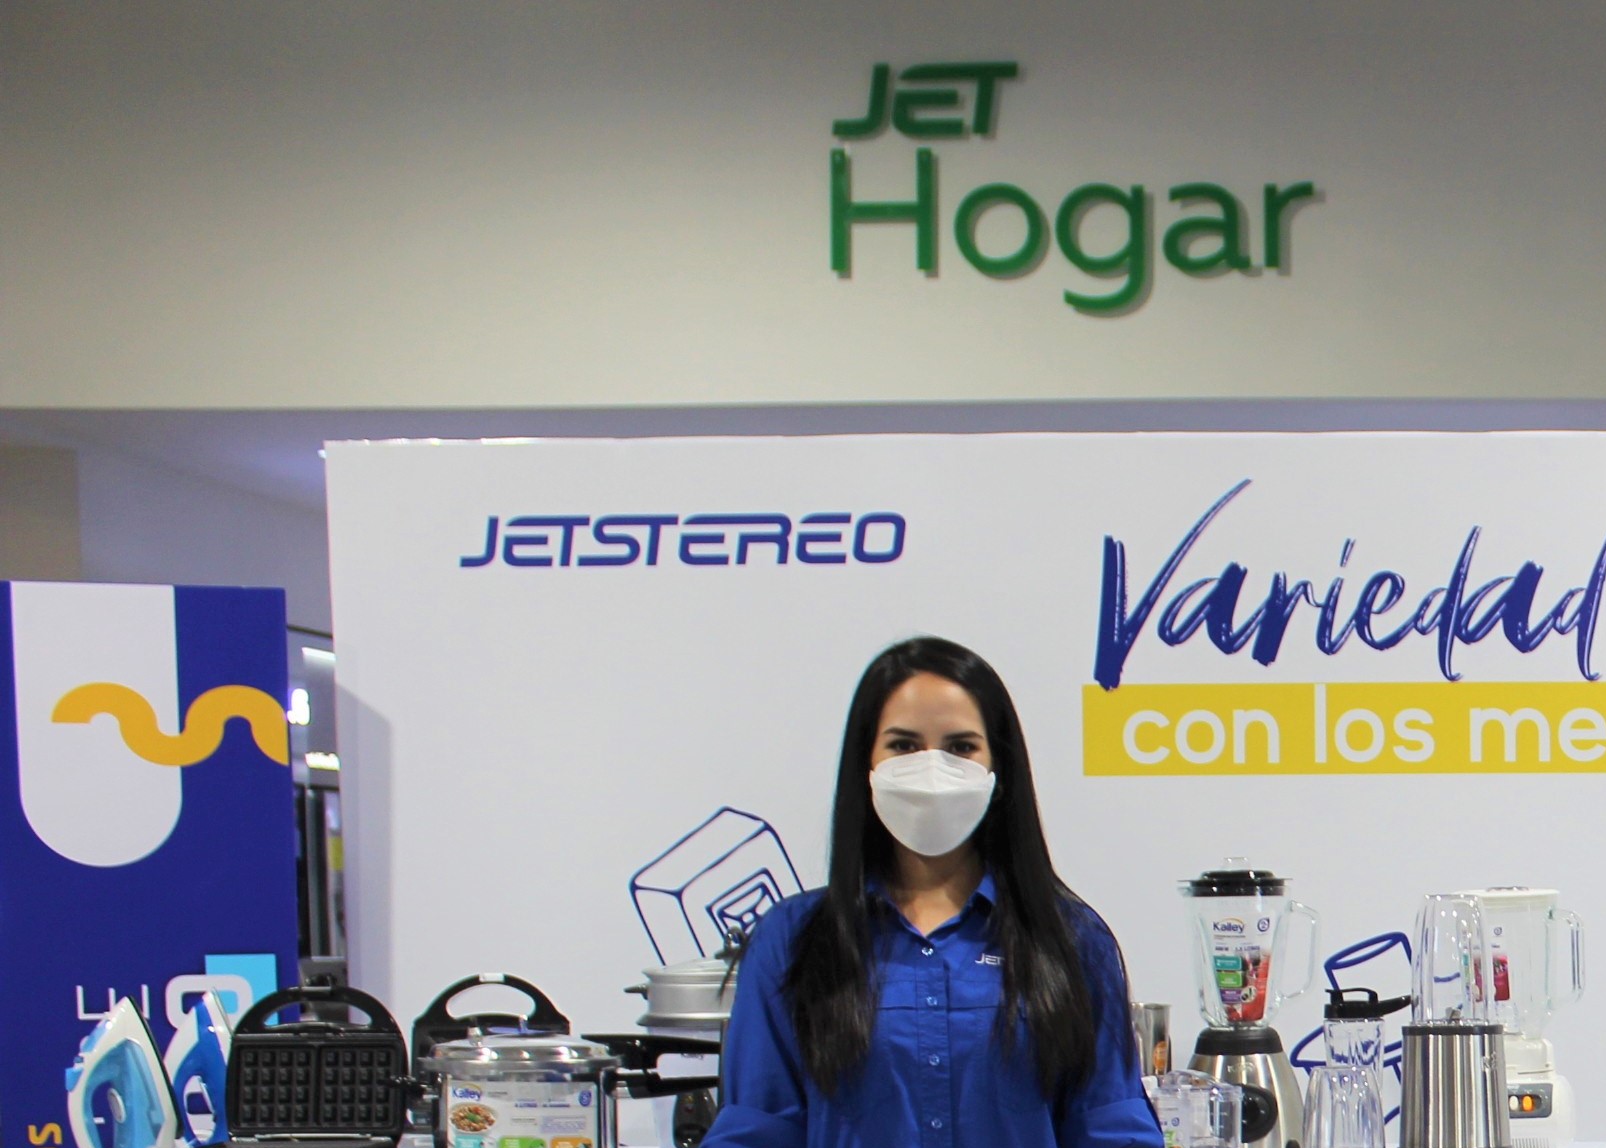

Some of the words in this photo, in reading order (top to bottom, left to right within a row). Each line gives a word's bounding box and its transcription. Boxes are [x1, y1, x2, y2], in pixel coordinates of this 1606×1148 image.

[832, 61, 1019, 137] JET
[829, 146, 1314, 312] Hogar
[460, 513, 905, 567] JETSTEREO
[1122, 708, 1281, 765] con
[1314, 688, 1436, 764] los
[974, 952, 1005, 966] JET
